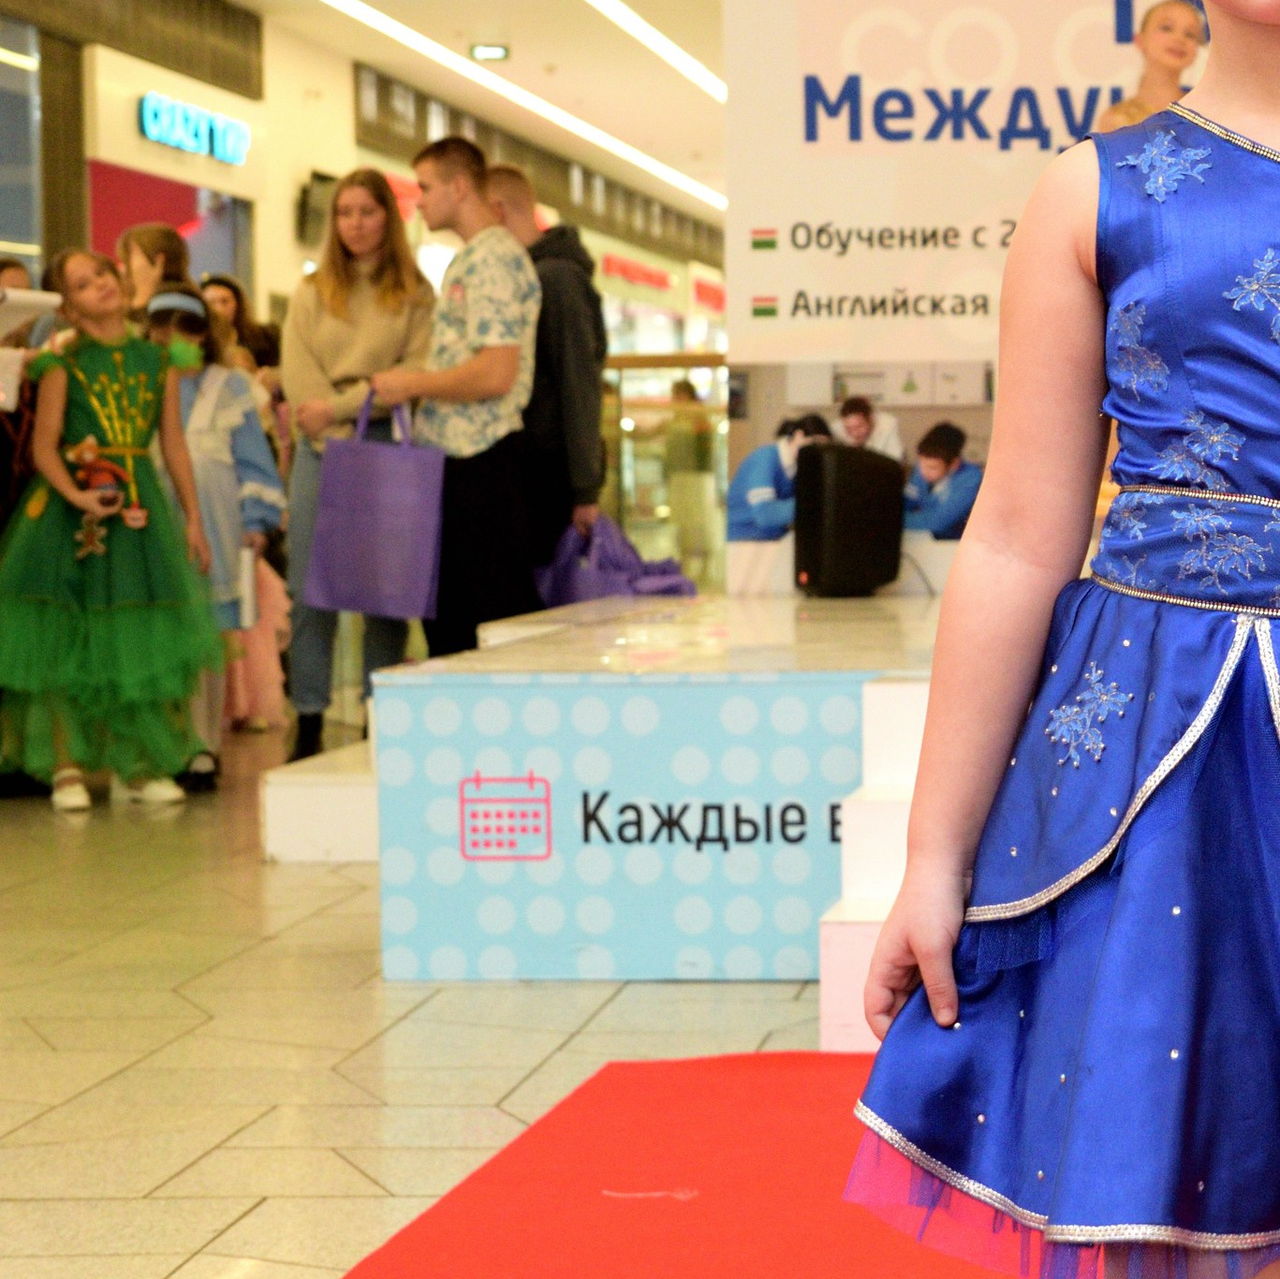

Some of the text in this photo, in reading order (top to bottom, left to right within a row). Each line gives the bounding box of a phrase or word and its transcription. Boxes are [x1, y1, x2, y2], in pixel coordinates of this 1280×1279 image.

[790, 222, 961, 256] Обучение
[972, 227, 987, 248] с
[791, 288, 990, 318] Английская
[581, 791, 808, 852] Каждые
